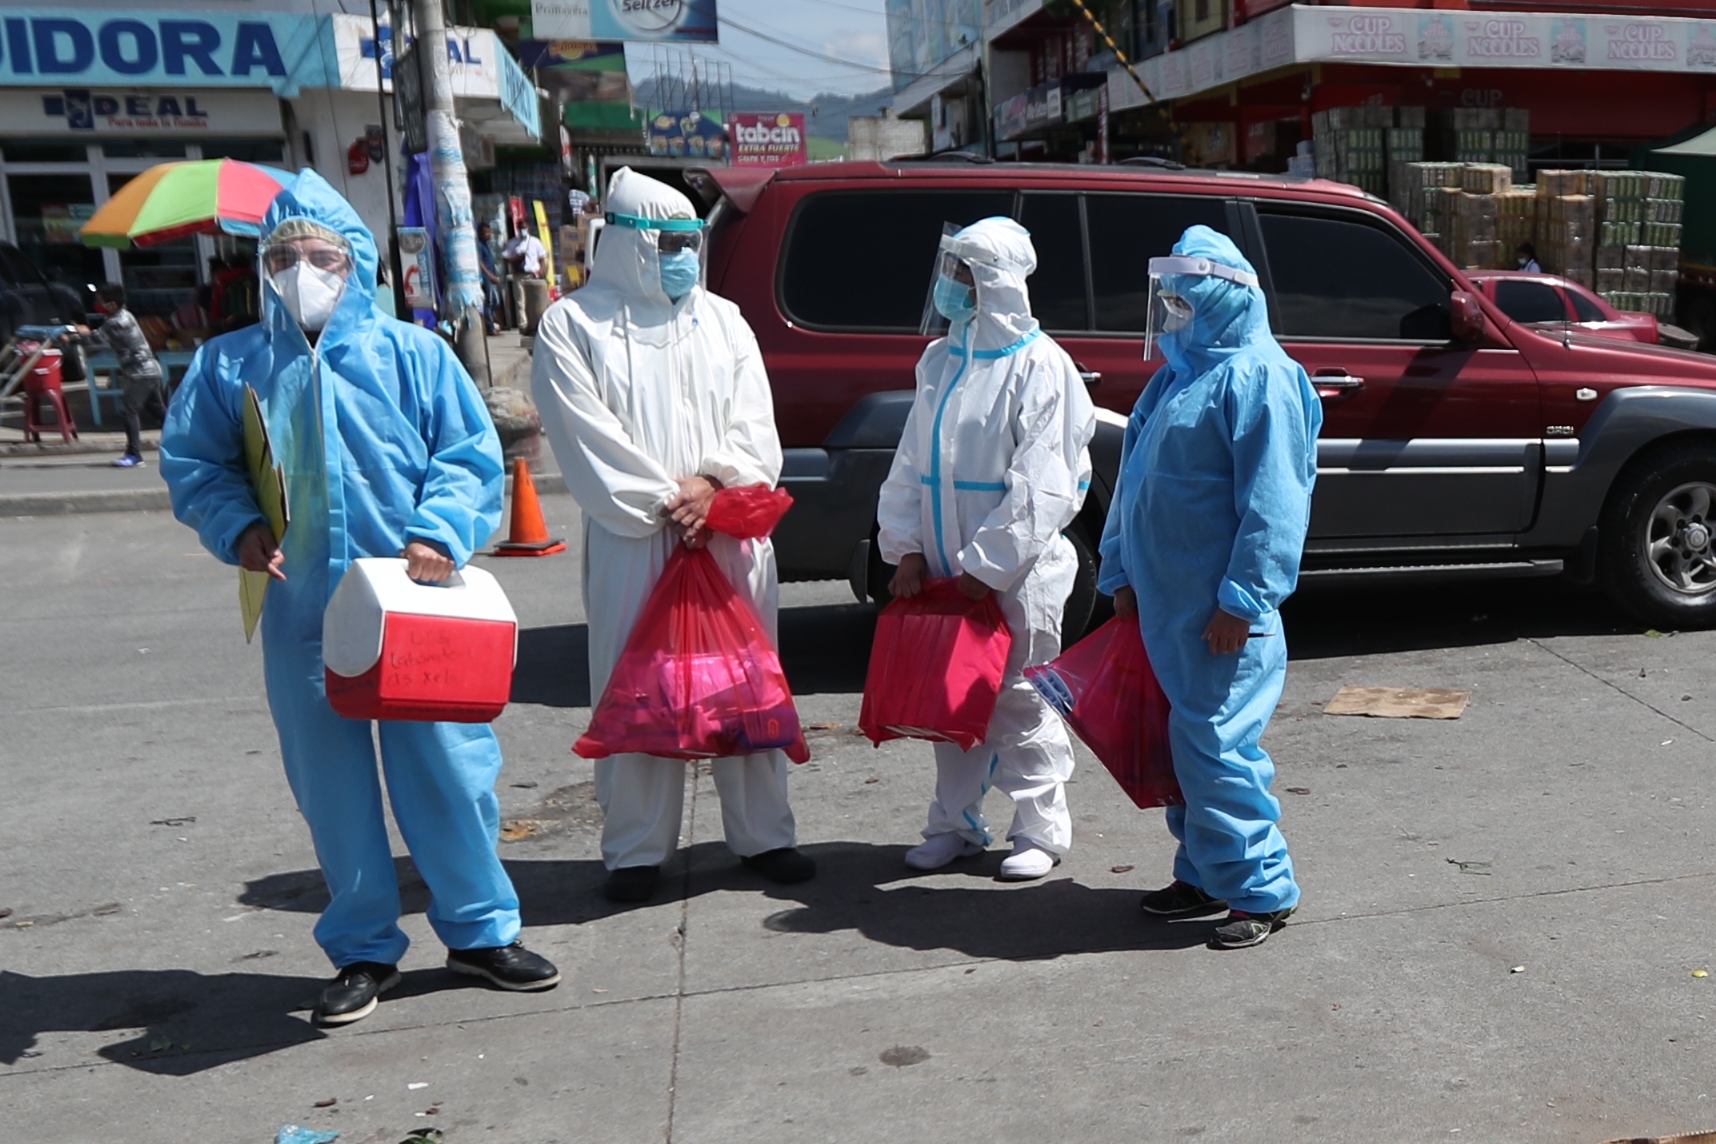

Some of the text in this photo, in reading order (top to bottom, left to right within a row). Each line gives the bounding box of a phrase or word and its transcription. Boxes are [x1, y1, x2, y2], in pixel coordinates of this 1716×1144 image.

[1349, 16, 1391, 35] CUP
[1484, 20, 1526, 38] CUP
[1625, 24, 1664, 42] CUP
[0, 17, 288, 76] IDORA
[1332, 33, 1406, 53] NOODLES
[1468, 37, 1540, 57] NOODLES
[1608, 41, 1676, 60] NOODLES
[1461, 88, 1502, 107] CUP
[735, 115, 800, 143] tabcin
[738, 143, 800, 152] EXTRA FUERTE
